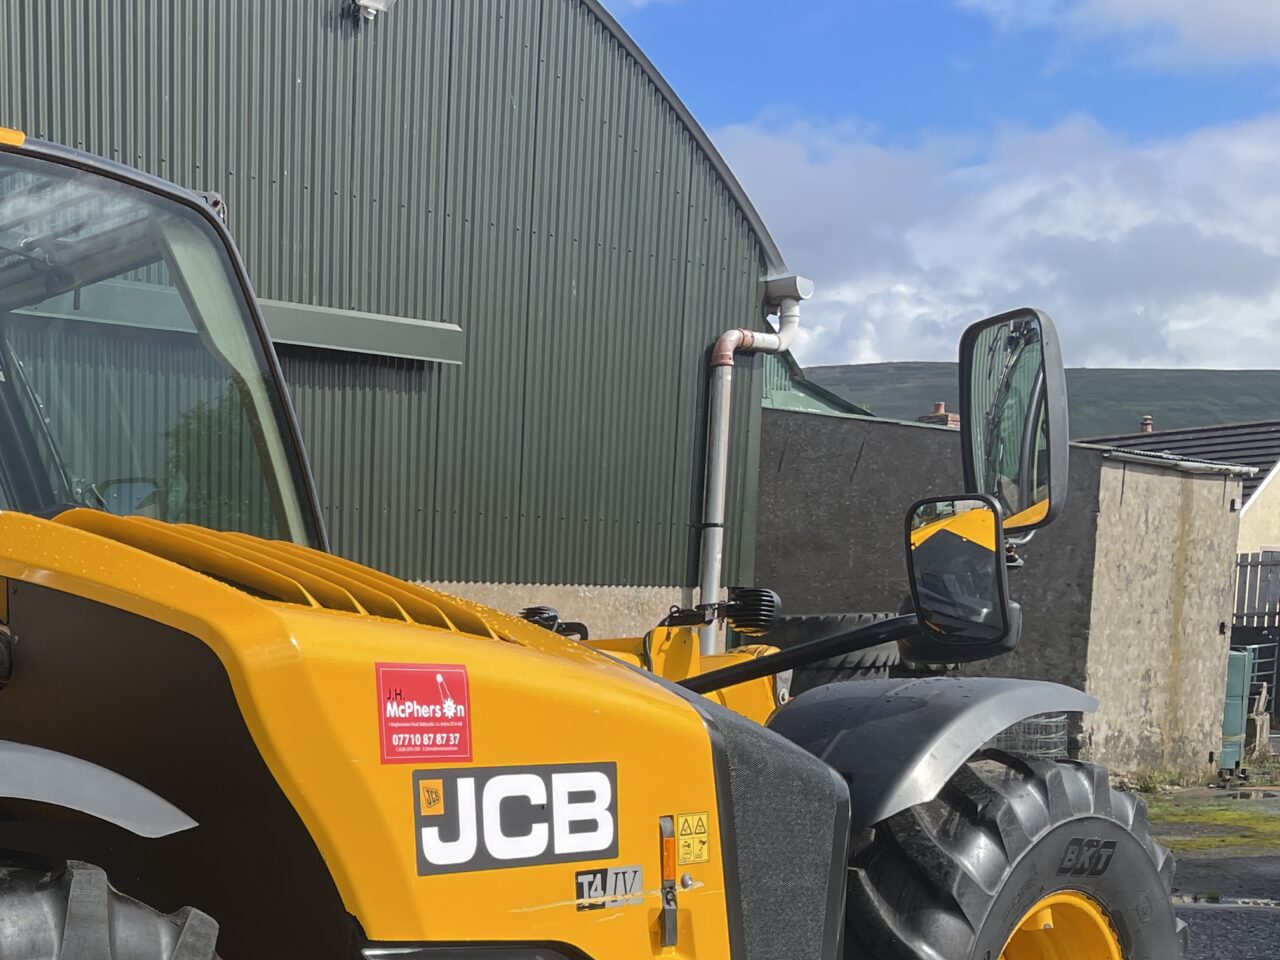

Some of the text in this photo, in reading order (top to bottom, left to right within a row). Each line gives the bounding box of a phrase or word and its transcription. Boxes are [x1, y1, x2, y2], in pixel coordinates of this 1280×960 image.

[392, 733, 422, 745] 07710
[449, 733, 460, 745] 37
[424, 787, 440, 805] JCB
[422, 771, 614, 865] JCB
[1059, 841, 1116, 873] BKT
